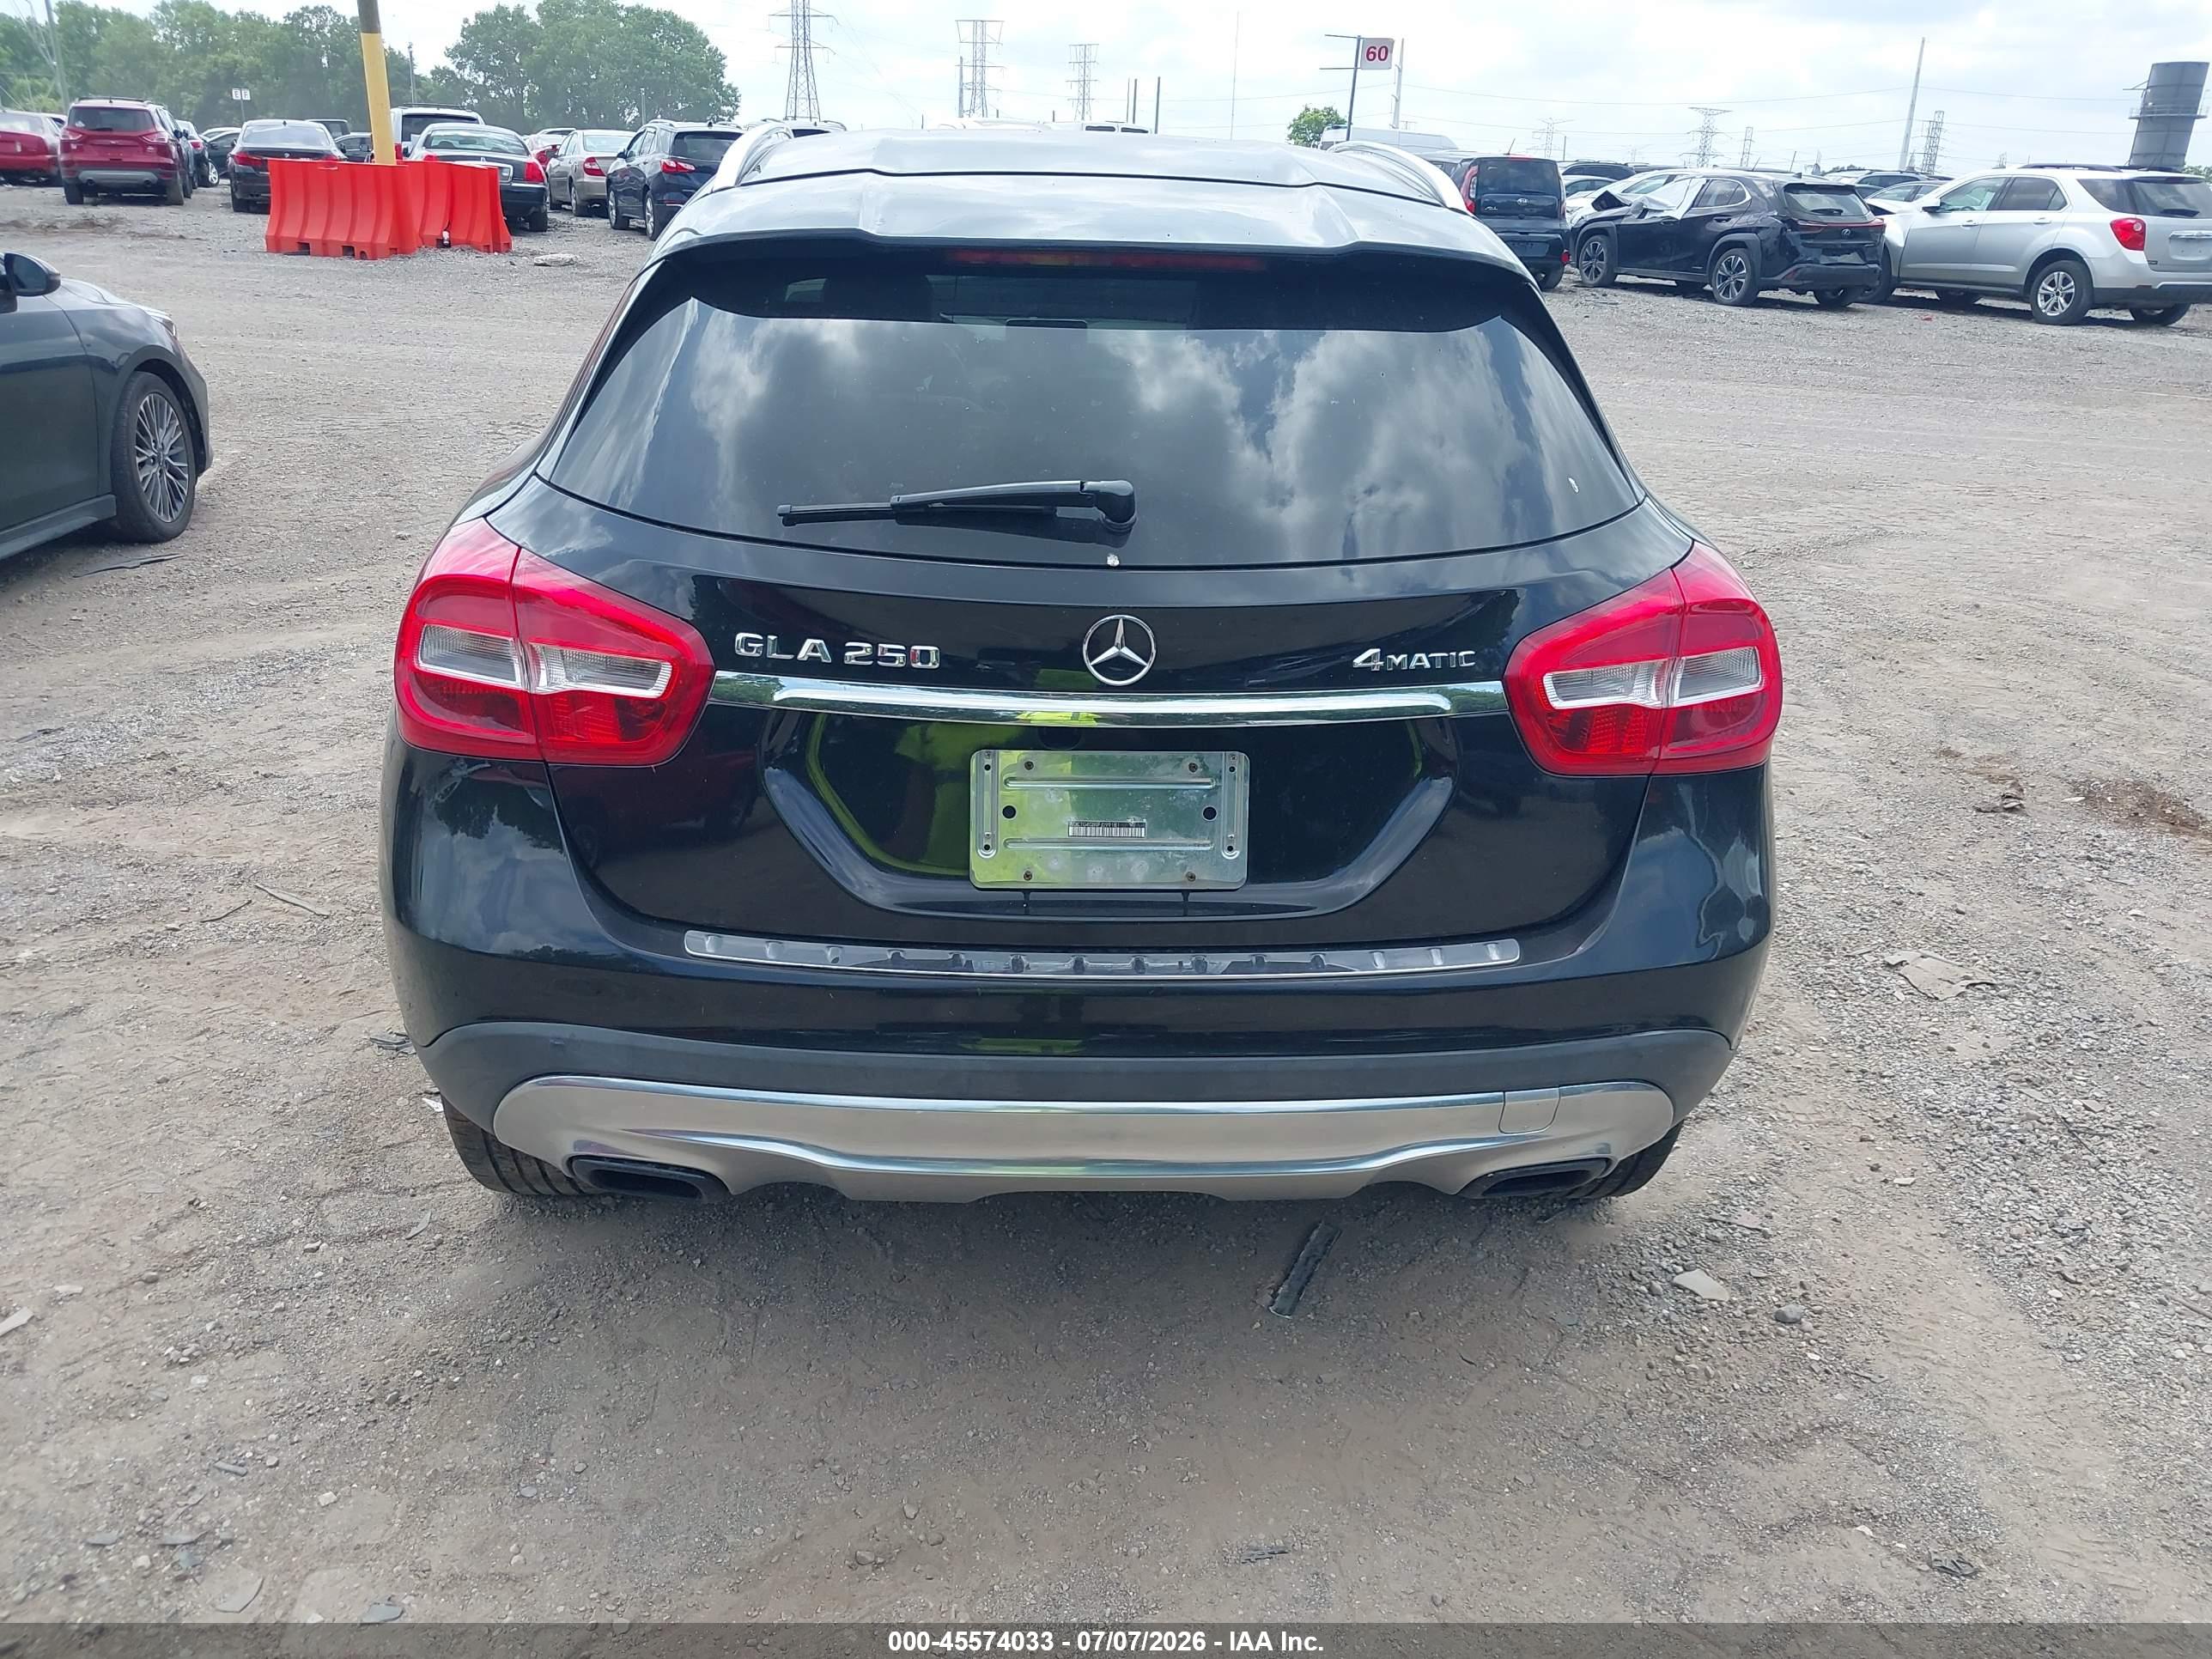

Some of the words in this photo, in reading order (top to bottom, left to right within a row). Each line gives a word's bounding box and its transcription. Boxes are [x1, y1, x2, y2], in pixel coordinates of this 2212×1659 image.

[1365, 46, 1389, 62] 60
[734, 632, 832, 664] GLA
[843, 641, 941, 670] 250
[1352, 647, 1476, 672] 4MATIC
